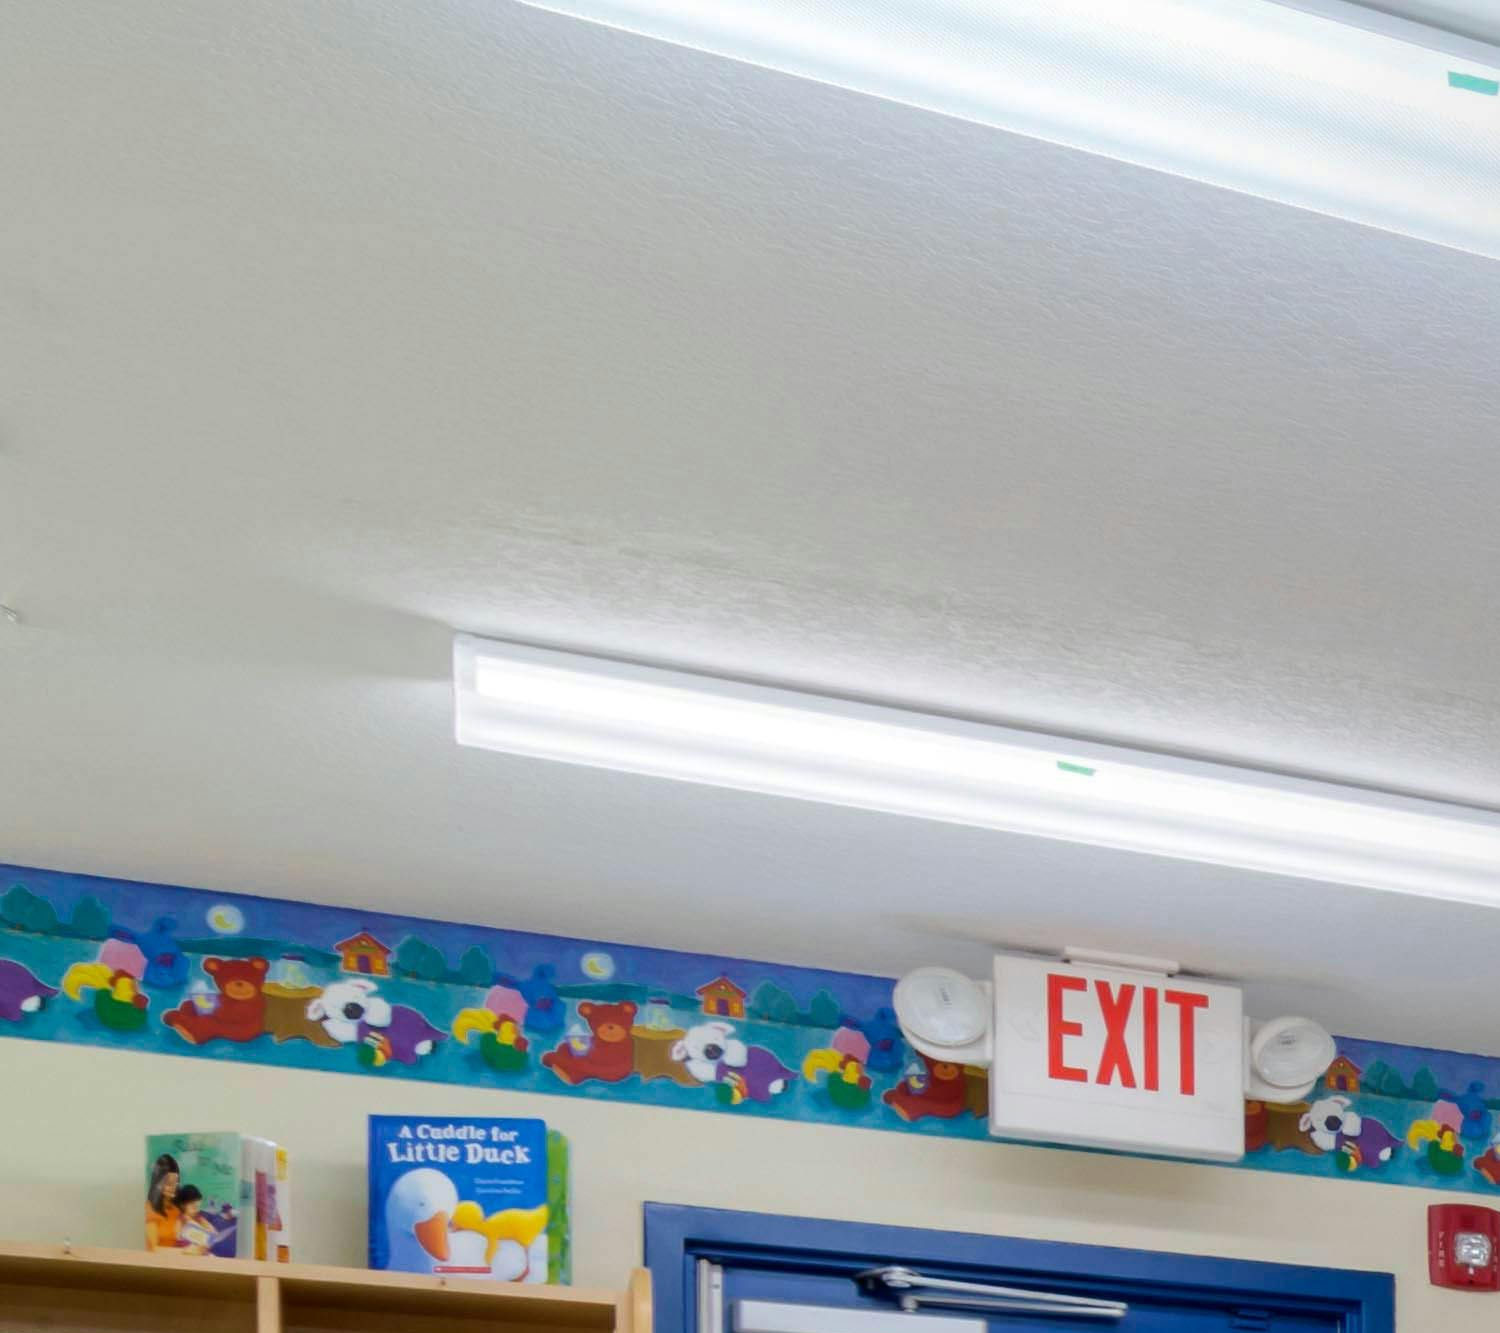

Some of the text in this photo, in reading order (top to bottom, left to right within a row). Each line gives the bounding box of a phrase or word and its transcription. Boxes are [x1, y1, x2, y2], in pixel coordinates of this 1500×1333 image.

[1046, 973, 1209, 1097] EXIT
[398, 1123, 519, 1142] A Cuddle for
[387, 1141, 532, 1165] Little Duck
